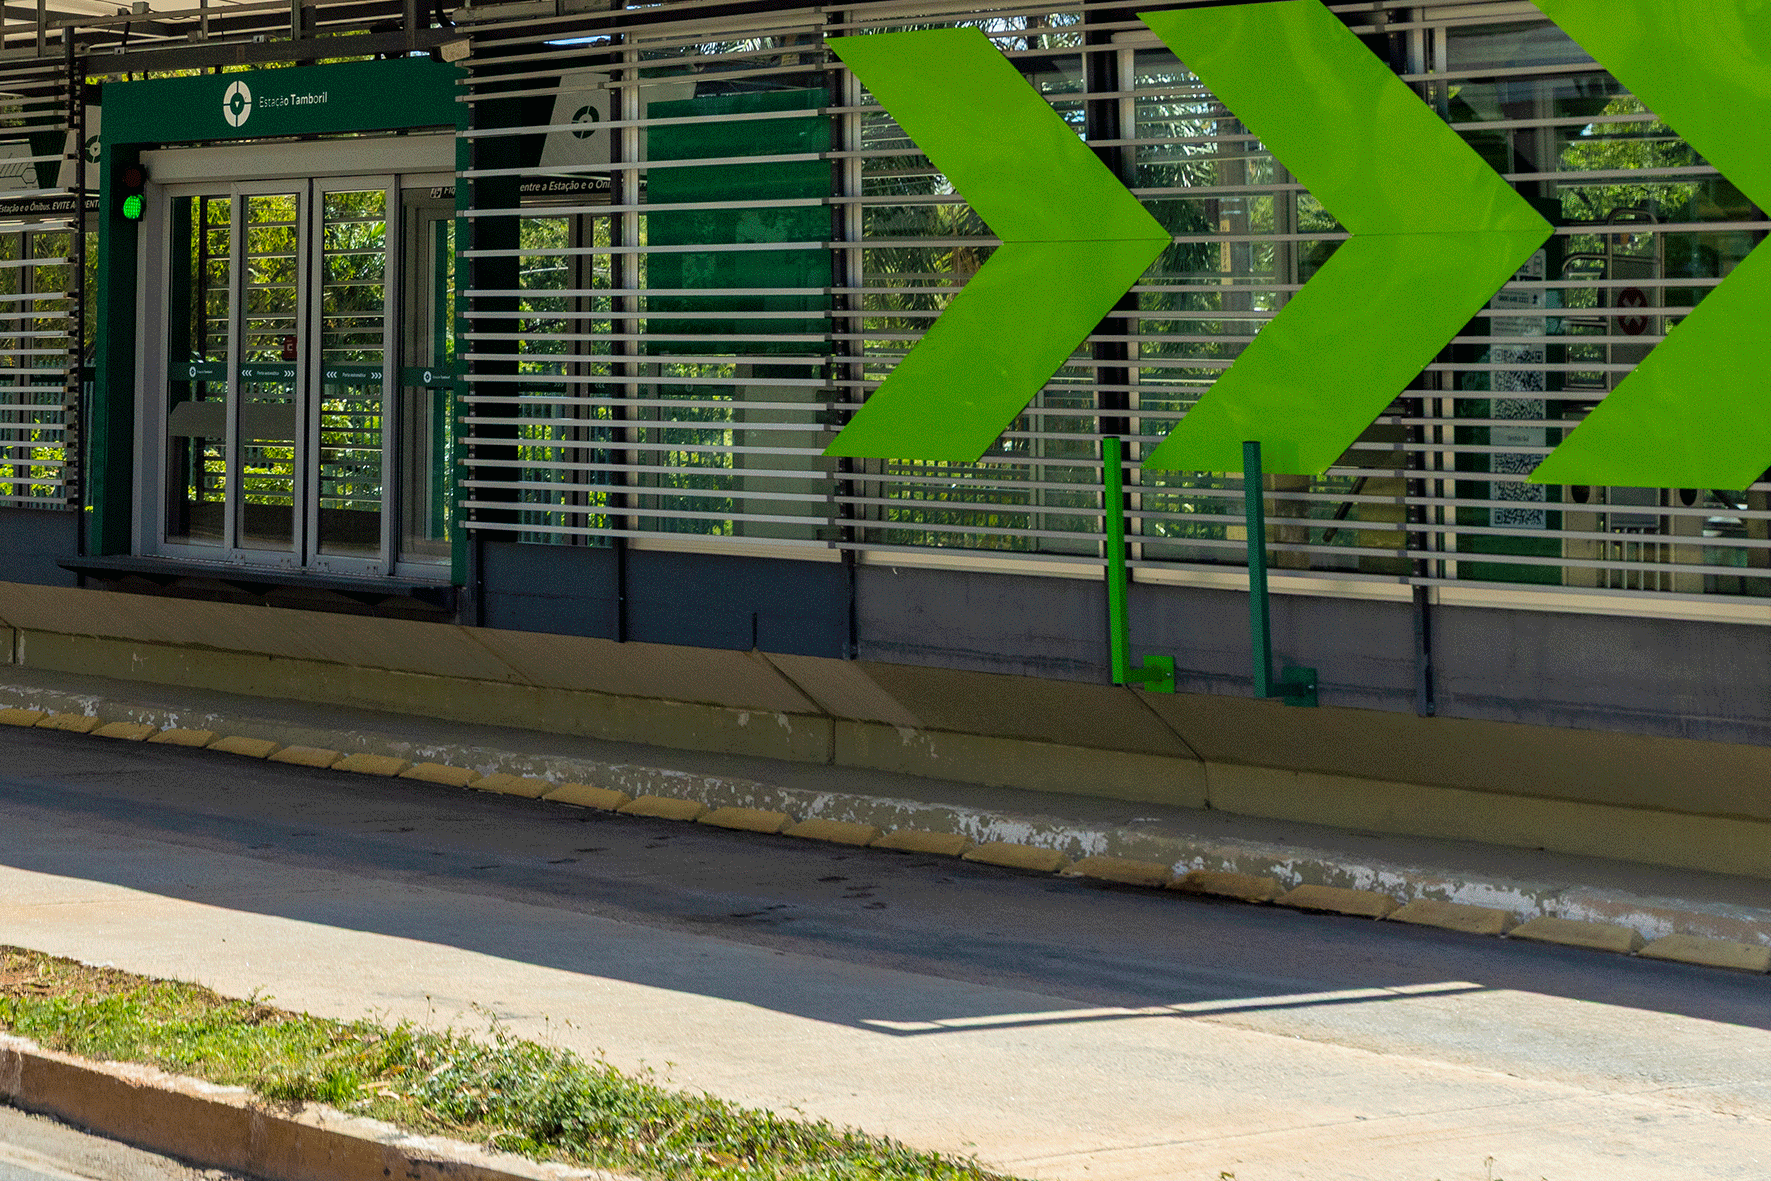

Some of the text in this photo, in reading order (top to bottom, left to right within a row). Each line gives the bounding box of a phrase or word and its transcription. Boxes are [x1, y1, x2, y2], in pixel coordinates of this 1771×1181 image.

[259, 90, 328, 108] Estação Tamboril
[520, 182, 541, 192] entre
[548, 180, 580, 192] Estação
[581, 182, 587, 190] e
[51, 200, 71, 210] EVITE
